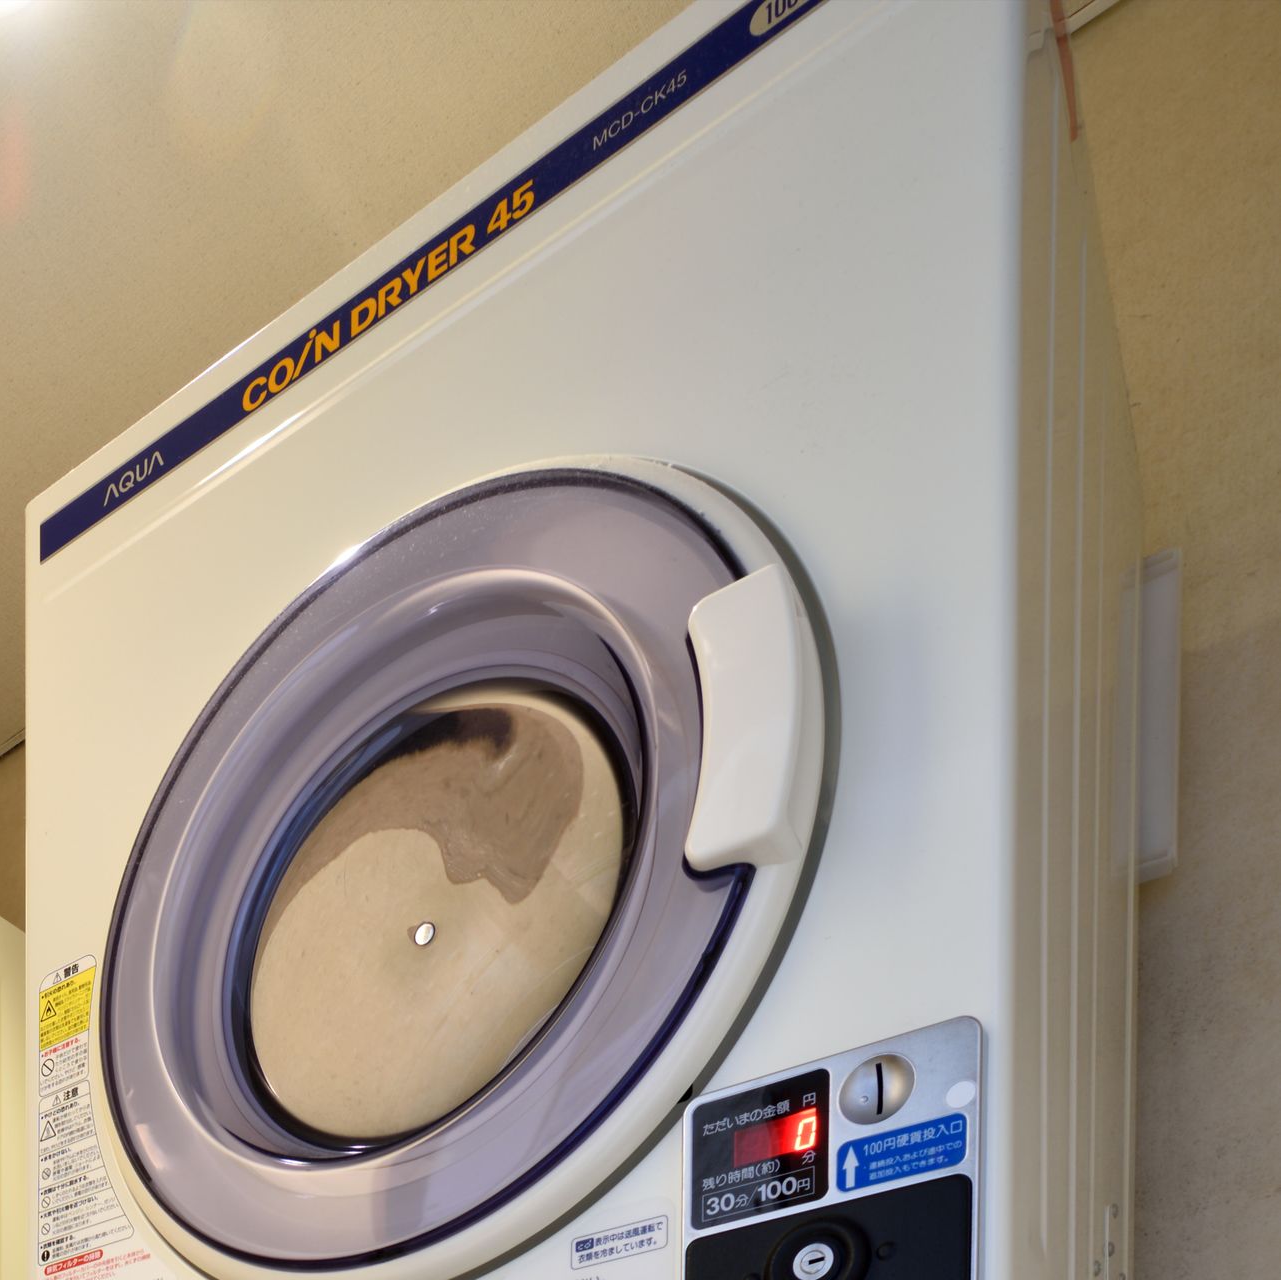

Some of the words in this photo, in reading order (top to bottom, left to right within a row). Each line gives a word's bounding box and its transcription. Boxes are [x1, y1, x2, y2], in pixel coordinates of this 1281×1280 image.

[592, 70, 687, 151] MCD-CK45
[351, 223, 476, 338] DRYER
[486, 179, 536, 235] 45
[103, 451, 164, 507] AQUA
[63, 1086, 79, 1101] 注意
[802, 1091, 817, 1107] 円
[702, 1099, 790, 1137] ただいまの金額
[794, 1115, 817, 1151] 0
[802, 1149, 817, 1165] 分
[863, 1119, 963, 1157] 100円硬貨投入口
